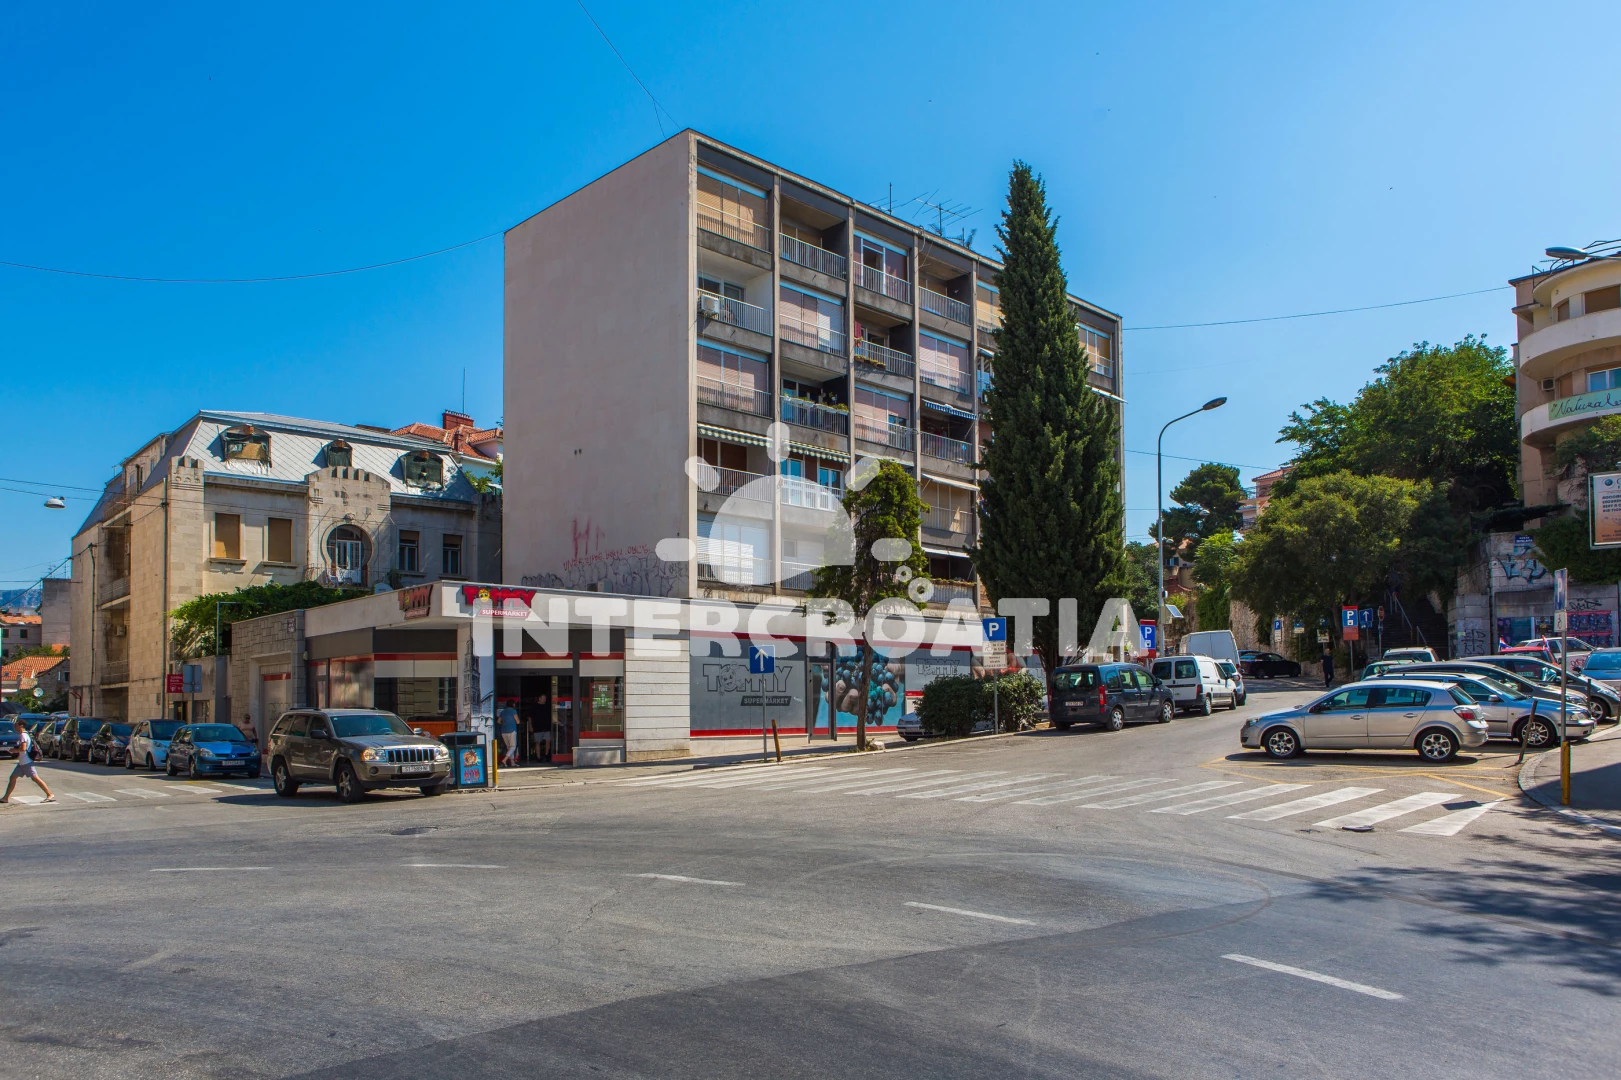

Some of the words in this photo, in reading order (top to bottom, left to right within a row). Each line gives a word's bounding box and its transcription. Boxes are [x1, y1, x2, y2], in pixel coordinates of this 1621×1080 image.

[1555, 393, 1621, 418] Naturale
[462, 585, 536, 609] TOMMY
[482, 609, 528, 618] SUPERMARKET
[1347, 610, 1354, 620] P
[989, 622, 1000, 637] P
[1144, 626, 1152, 639] P
[703, 662, 793, 693] TOMMY
